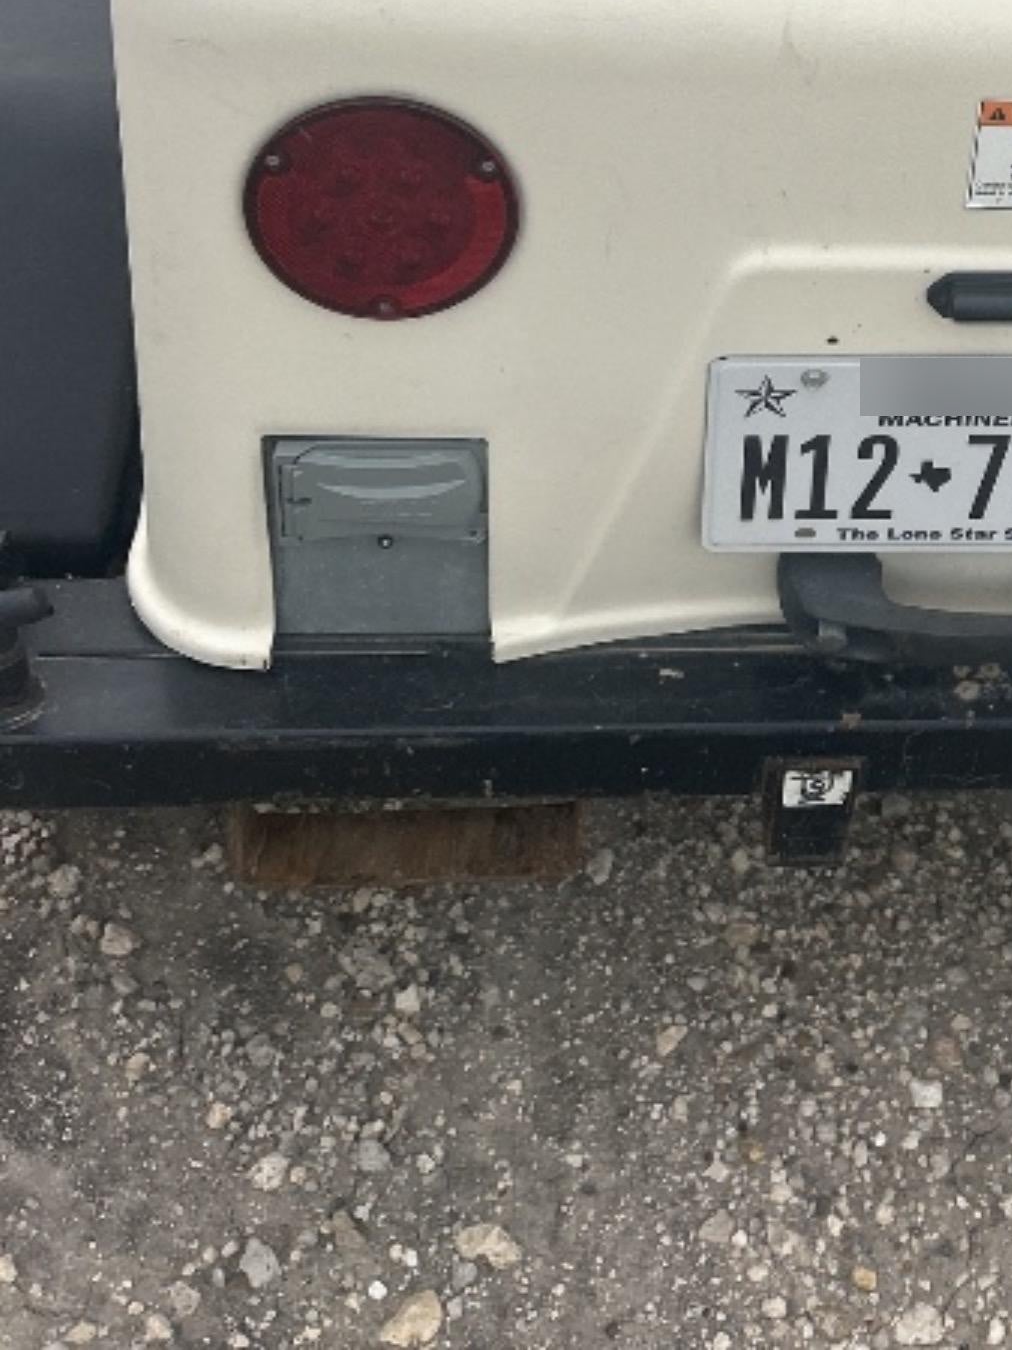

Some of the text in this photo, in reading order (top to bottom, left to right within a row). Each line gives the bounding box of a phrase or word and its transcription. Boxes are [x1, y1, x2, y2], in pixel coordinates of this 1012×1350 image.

[739, 434, 899, 521] M12
[836, 527, 880, 541] The
[887, 527, 943, 541] Lone
[950, 527, 998, 541] Star
